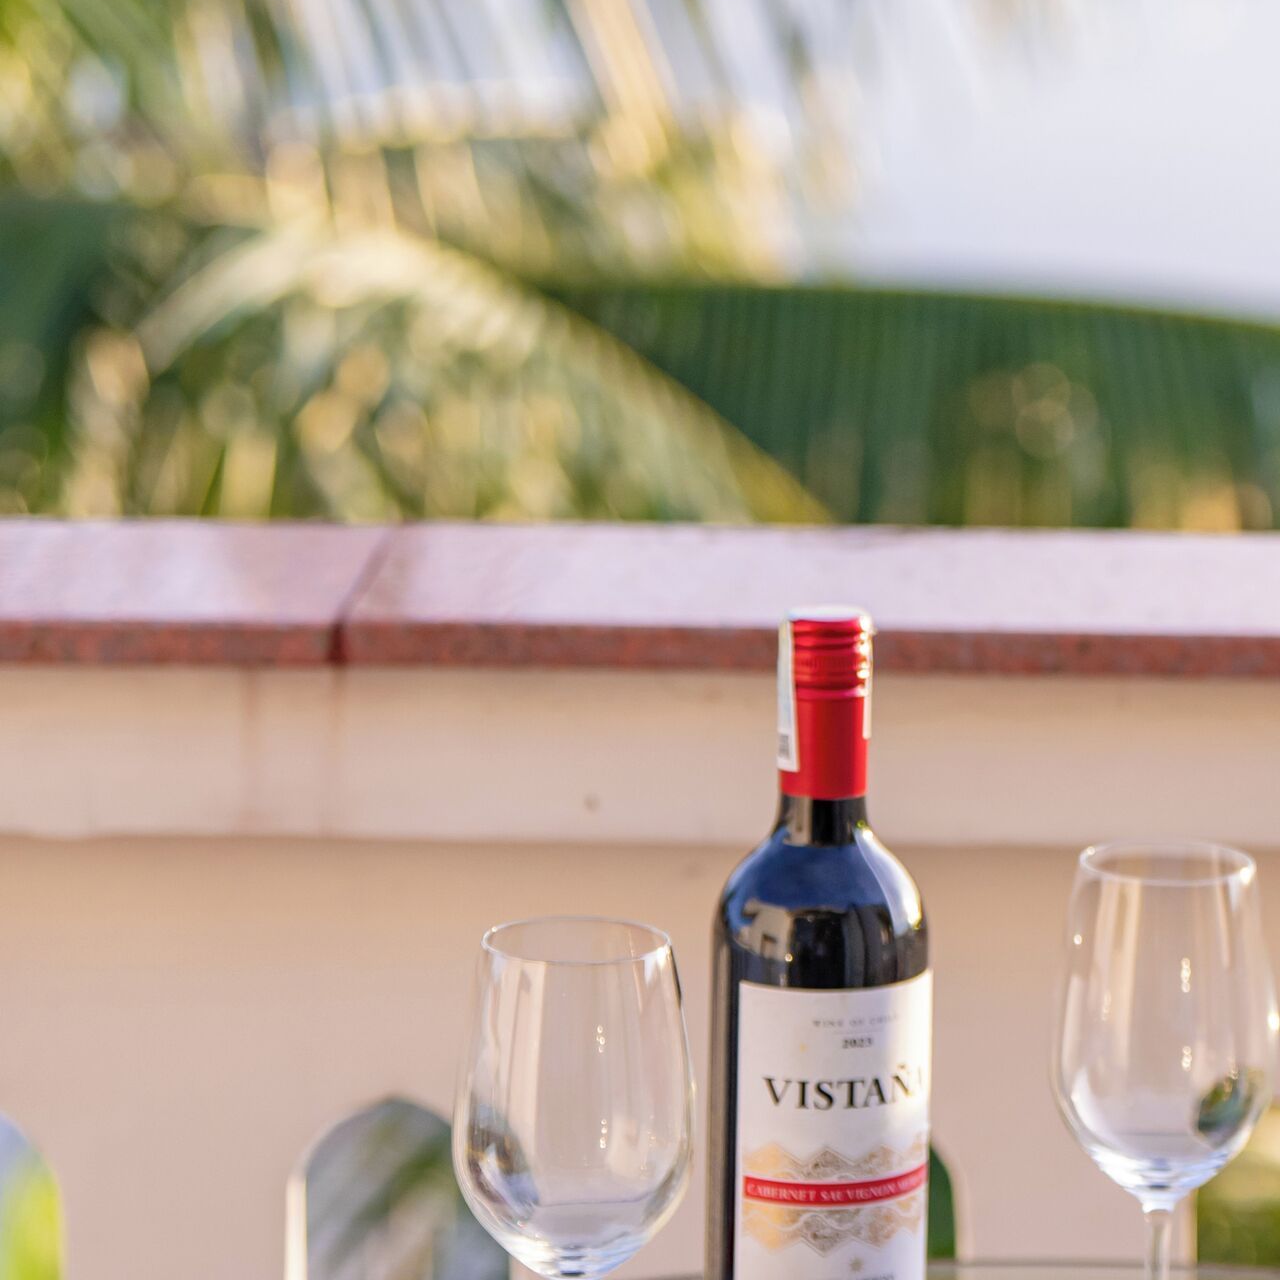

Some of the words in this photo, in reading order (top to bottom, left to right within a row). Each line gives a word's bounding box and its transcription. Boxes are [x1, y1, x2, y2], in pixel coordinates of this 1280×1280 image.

[762, 1064, 923, 1111] VISTAÑ
[746, 1183, 817, 1202] CABERNET
[820, 1184, 897, 1203] SAUVIGNON
